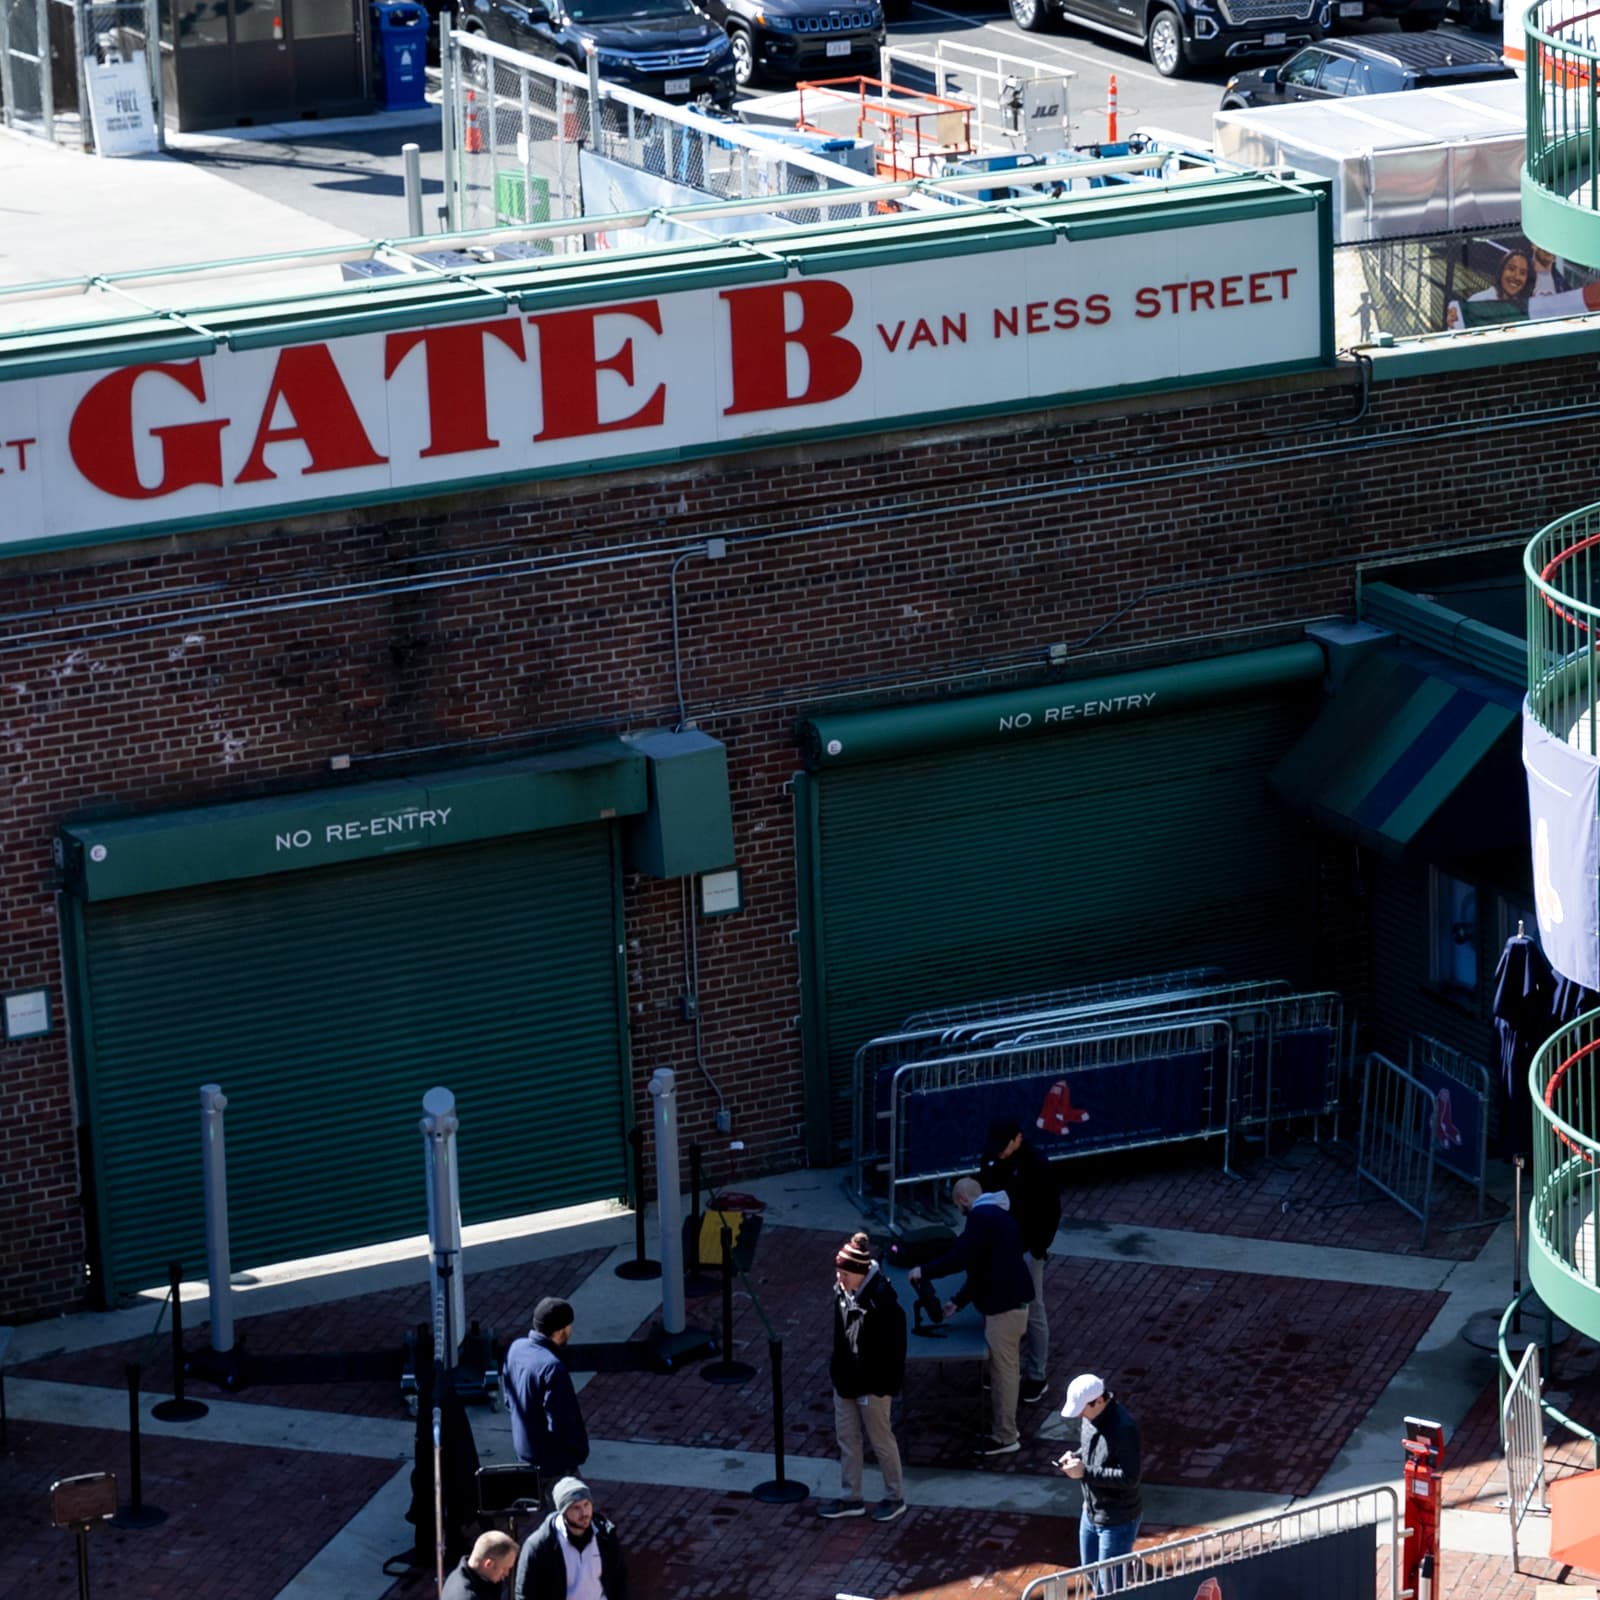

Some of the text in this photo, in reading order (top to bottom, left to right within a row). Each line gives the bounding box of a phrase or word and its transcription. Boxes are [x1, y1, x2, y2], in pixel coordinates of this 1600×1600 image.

[1031, 103, 1059, 119] JLG
[877, 267, 1298, 352] VAN NESS STREET
[68, 279, 863, 501] GATE B
[997, 691, 1158, 732] NO RE-ENTRY
[274, 806, 453, 853] NO RE-ENTRY
